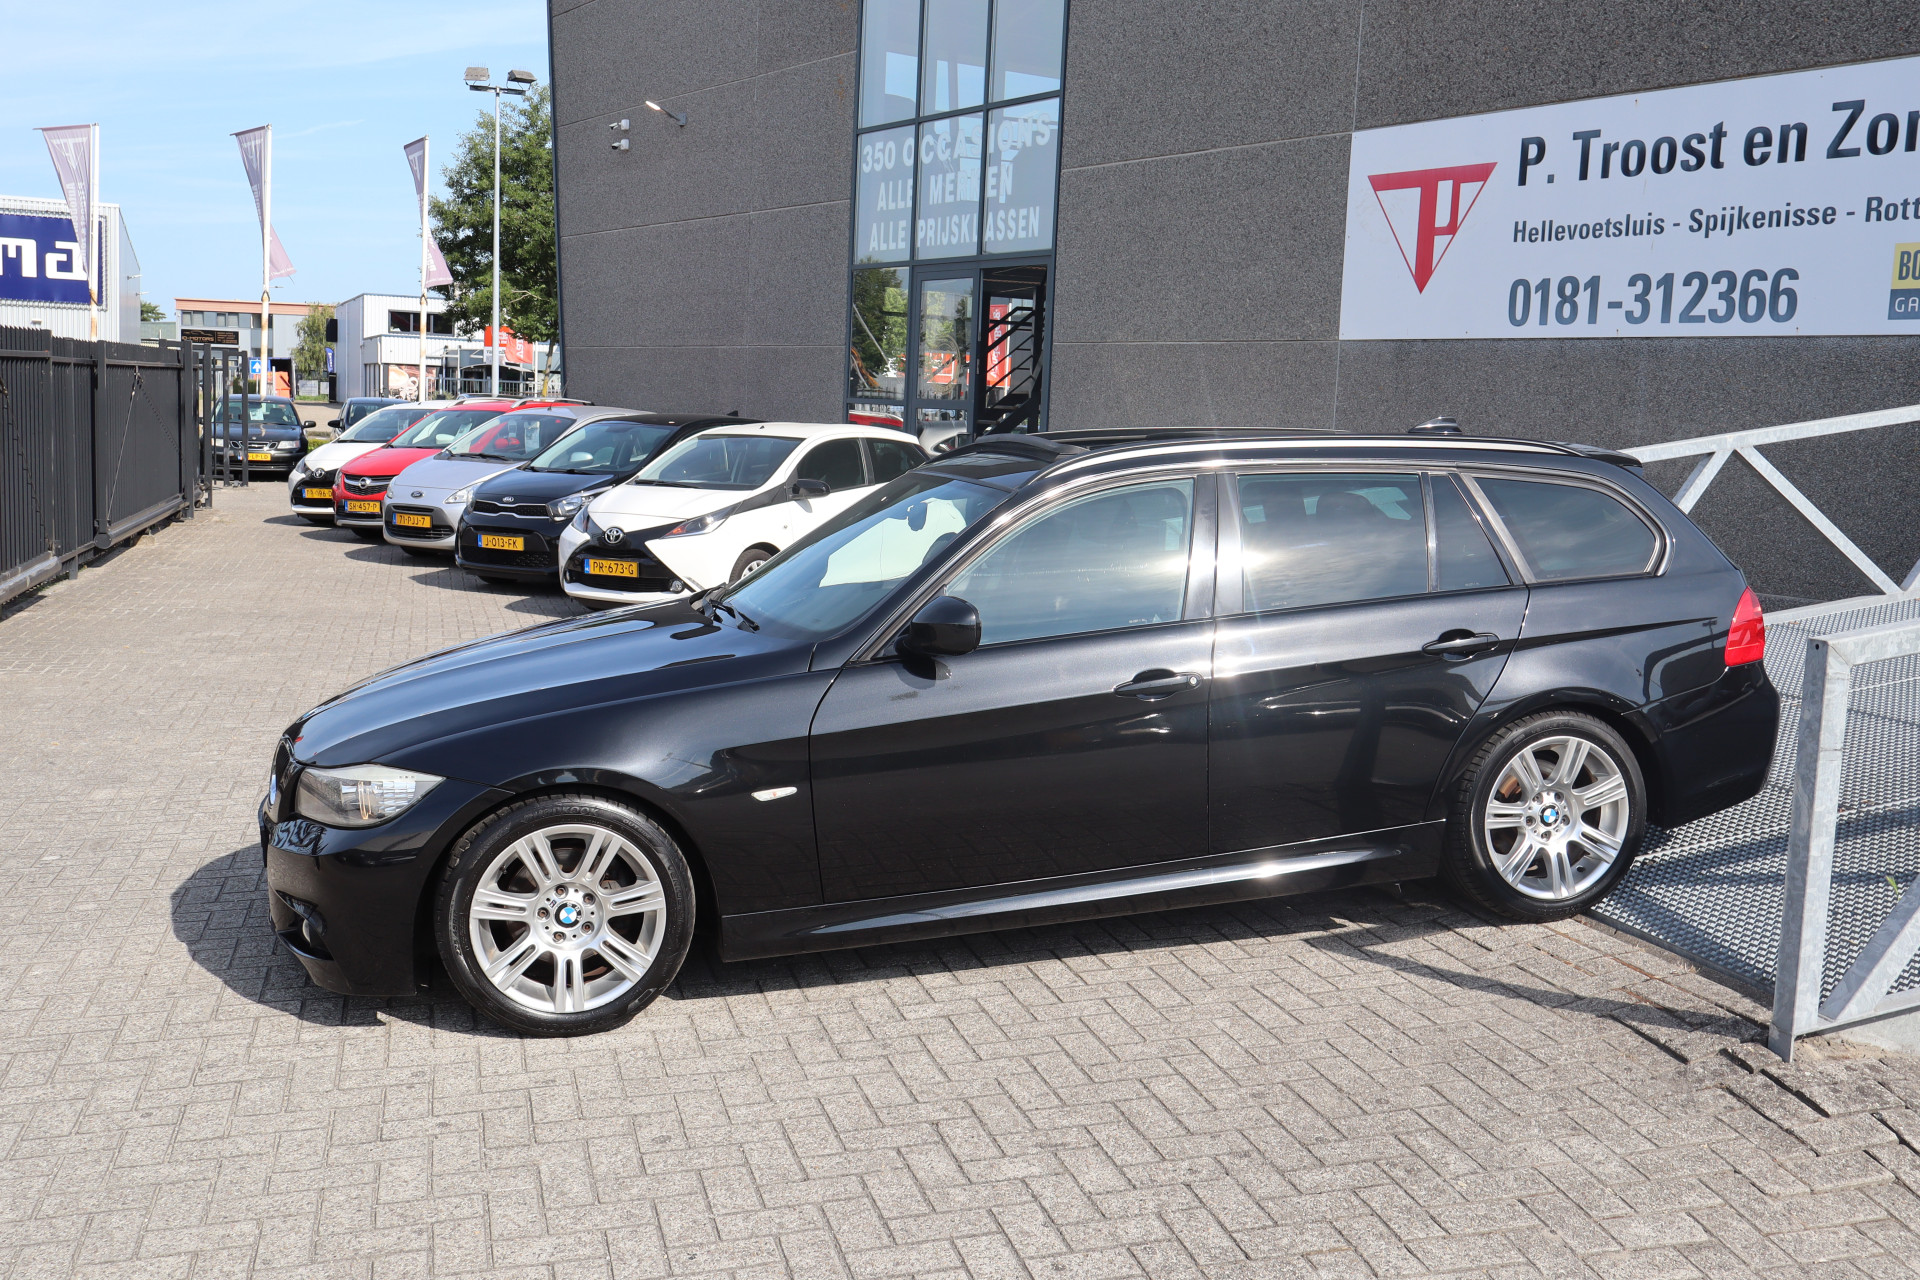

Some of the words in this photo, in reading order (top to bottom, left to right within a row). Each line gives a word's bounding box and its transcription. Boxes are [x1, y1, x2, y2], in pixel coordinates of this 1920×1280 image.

[862, 141, 896, 174] 350
[902, 113, 1051, 167] OCCASIONS
[1517, 136, 1555, 187] P.
[1572, 121, 1727, 181] Troost
[1743, 121, 1809, 167] en
[877, 178, 913, 211] ALLE
[869, 219, 906, 251] ALLE
[917, 206, 1040, 248] PRIJSKLASSEN
[1512, 212, 1666, 243] Hellevoetsluis
[1688, 202, 1838, 238] Spijkenisse
[1508, 267, 1800, 328] 0181-312366
[399, 514, 426, 526] 71-PJJ-7
[484, 536, 519, 549] J-013-FK
[592, 560, 634, 575] PR-673-G
